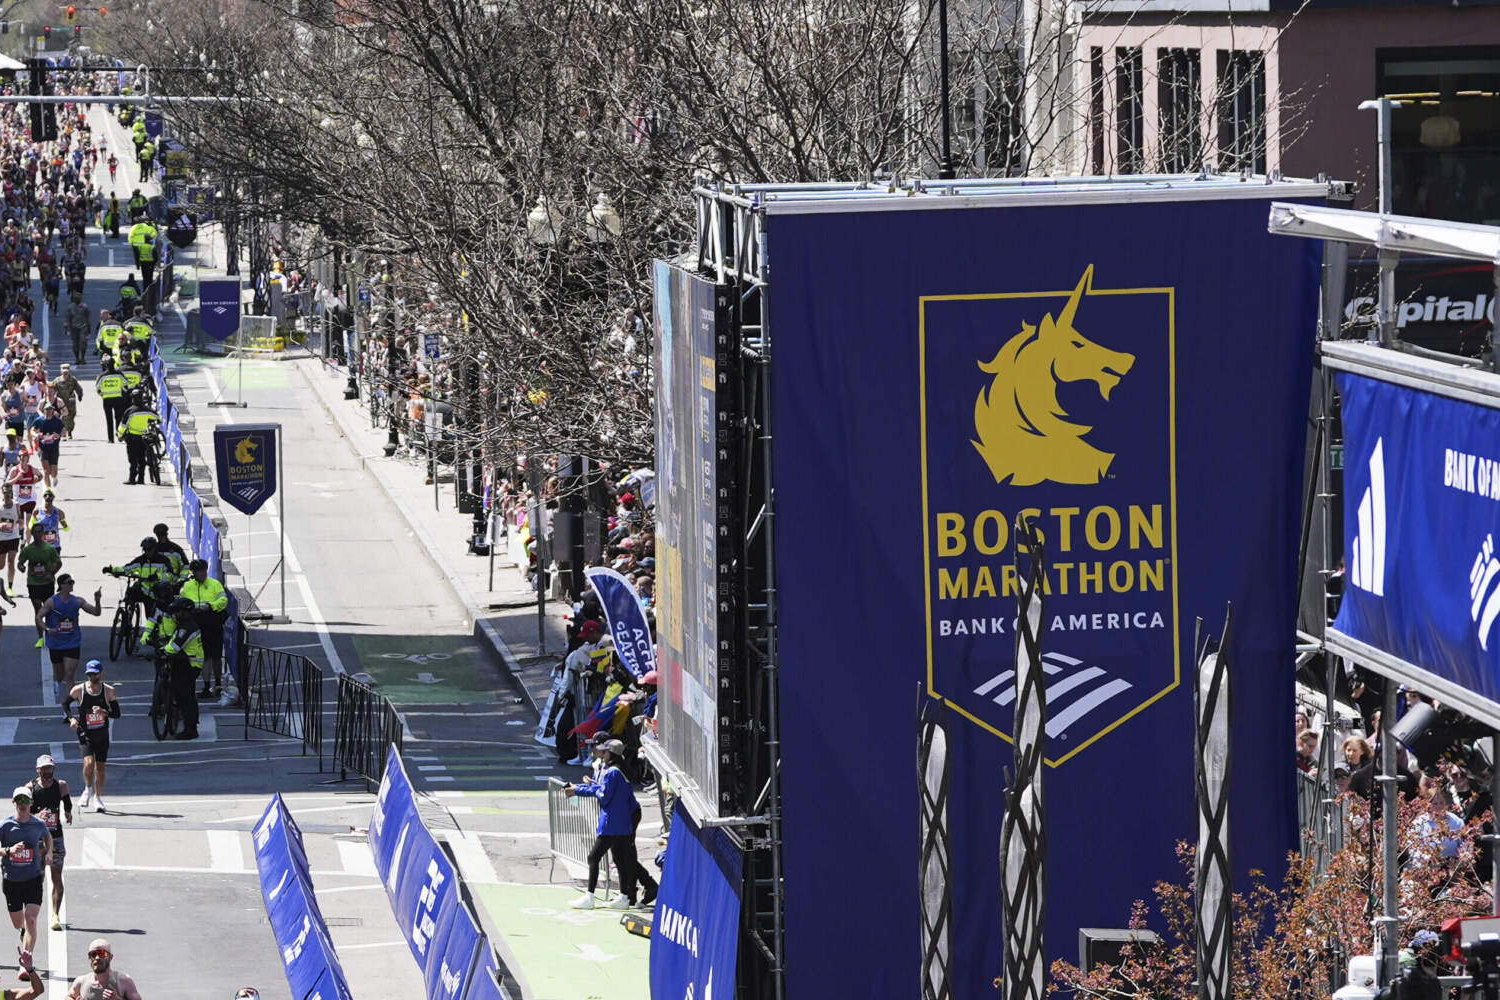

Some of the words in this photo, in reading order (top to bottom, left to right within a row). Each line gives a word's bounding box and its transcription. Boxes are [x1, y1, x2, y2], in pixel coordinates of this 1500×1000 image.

[231, 466, 262, 474] BOSTON
[1445, 448, 1477, 492] BANK
[937, 504, 1163, 557] BOSTON
[940, 617, 1005, 636] BANK
[1050, 611, 1165, 632] AMERICA
